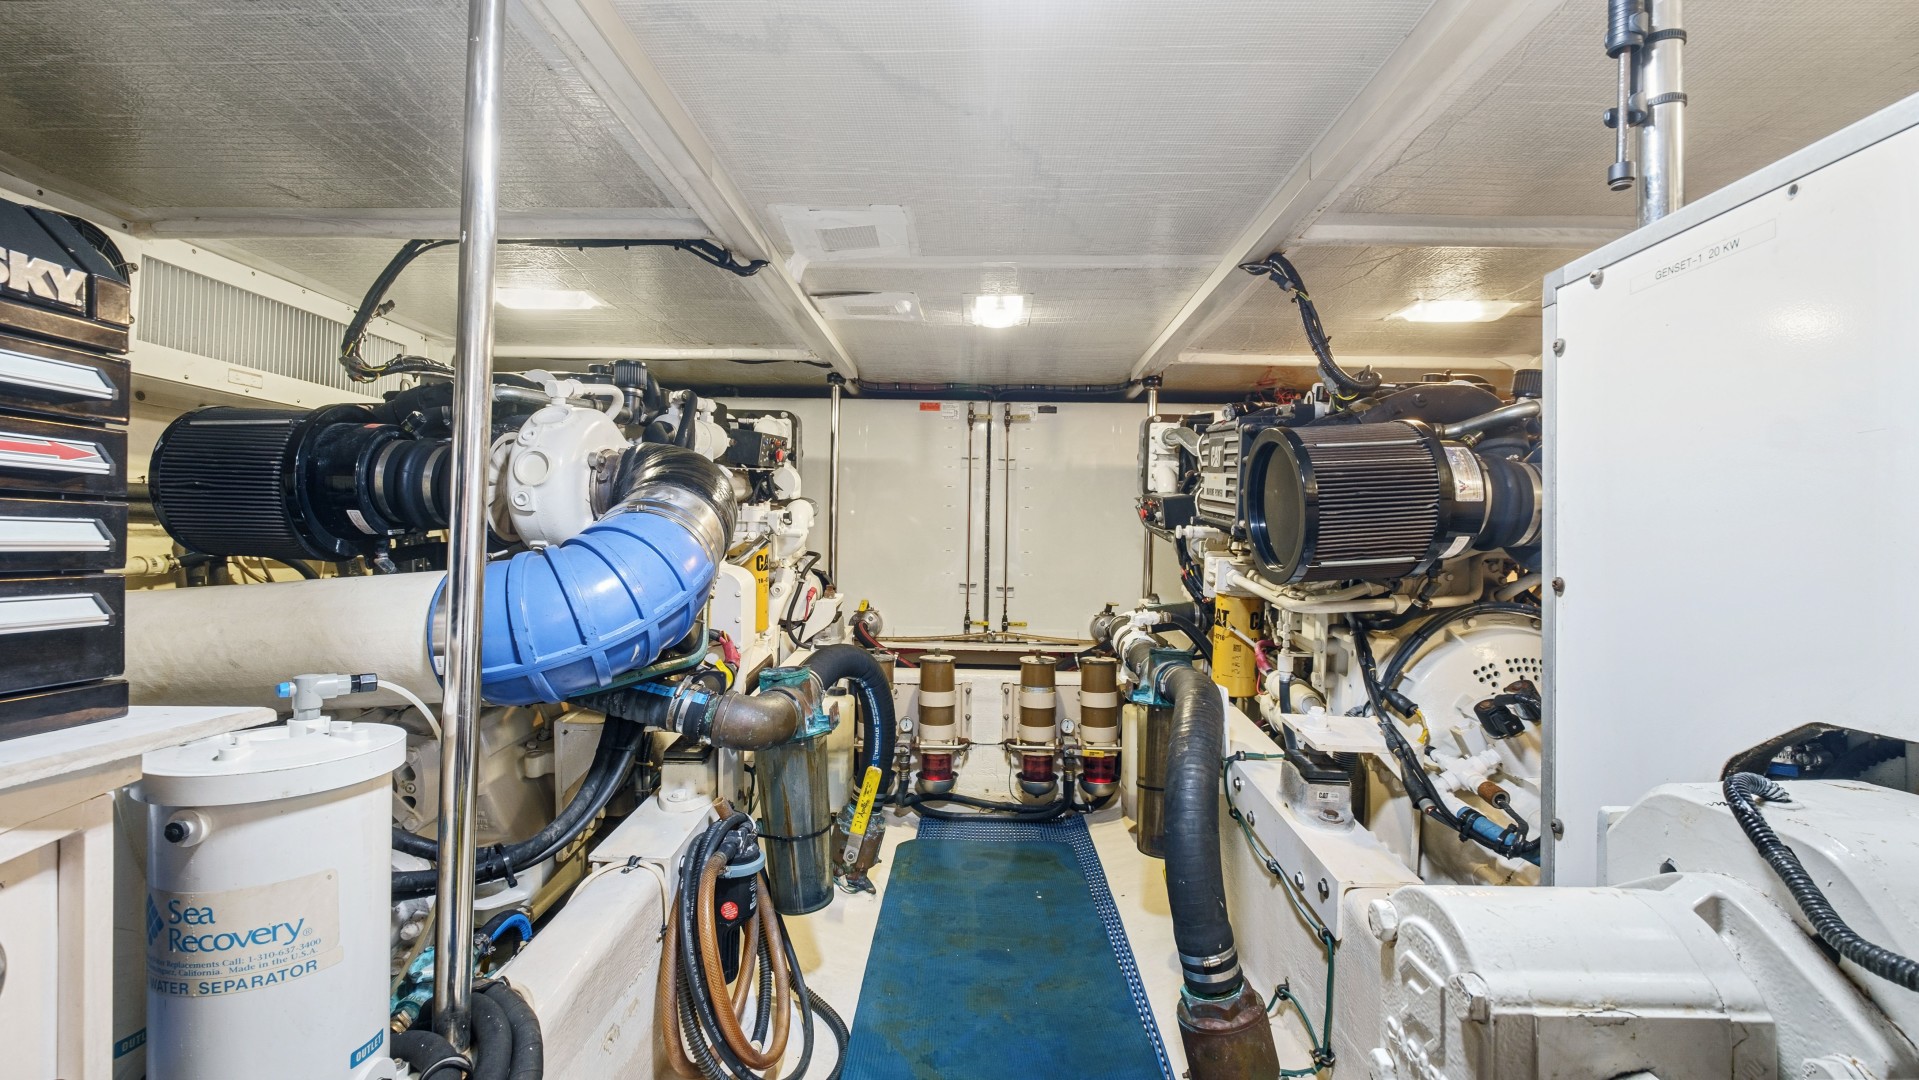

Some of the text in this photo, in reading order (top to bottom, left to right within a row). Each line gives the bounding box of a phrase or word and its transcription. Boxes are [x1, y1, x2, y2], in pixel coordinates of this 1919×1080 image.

[1655, 238, 1740, 280] GENSET-1 20 KW
[0, 246, 88, 307] KY
[1318, 791, 1329, 799] CAT
[168, 899, 216, 925] Sea
[168, 917, 305, 953] Recovery
[168, 960, 220, 970] Replacements
[222, 957, 245, 968] Call:
[249, 938, 322, 963] 1-310-637-3400
[178, 968, 223, 977] California.
[229, 963, 255, 975] Made
[259, 961, 269, 969] in
[272, 957, 288, 966] the
[290, 947, 319, 961] U.S.A.
[198, 960, 318, 995] SEPARATOR
[122, 1031, 145, 1052] OUTL
[356, 1034, 382, 1062] OUTLET
